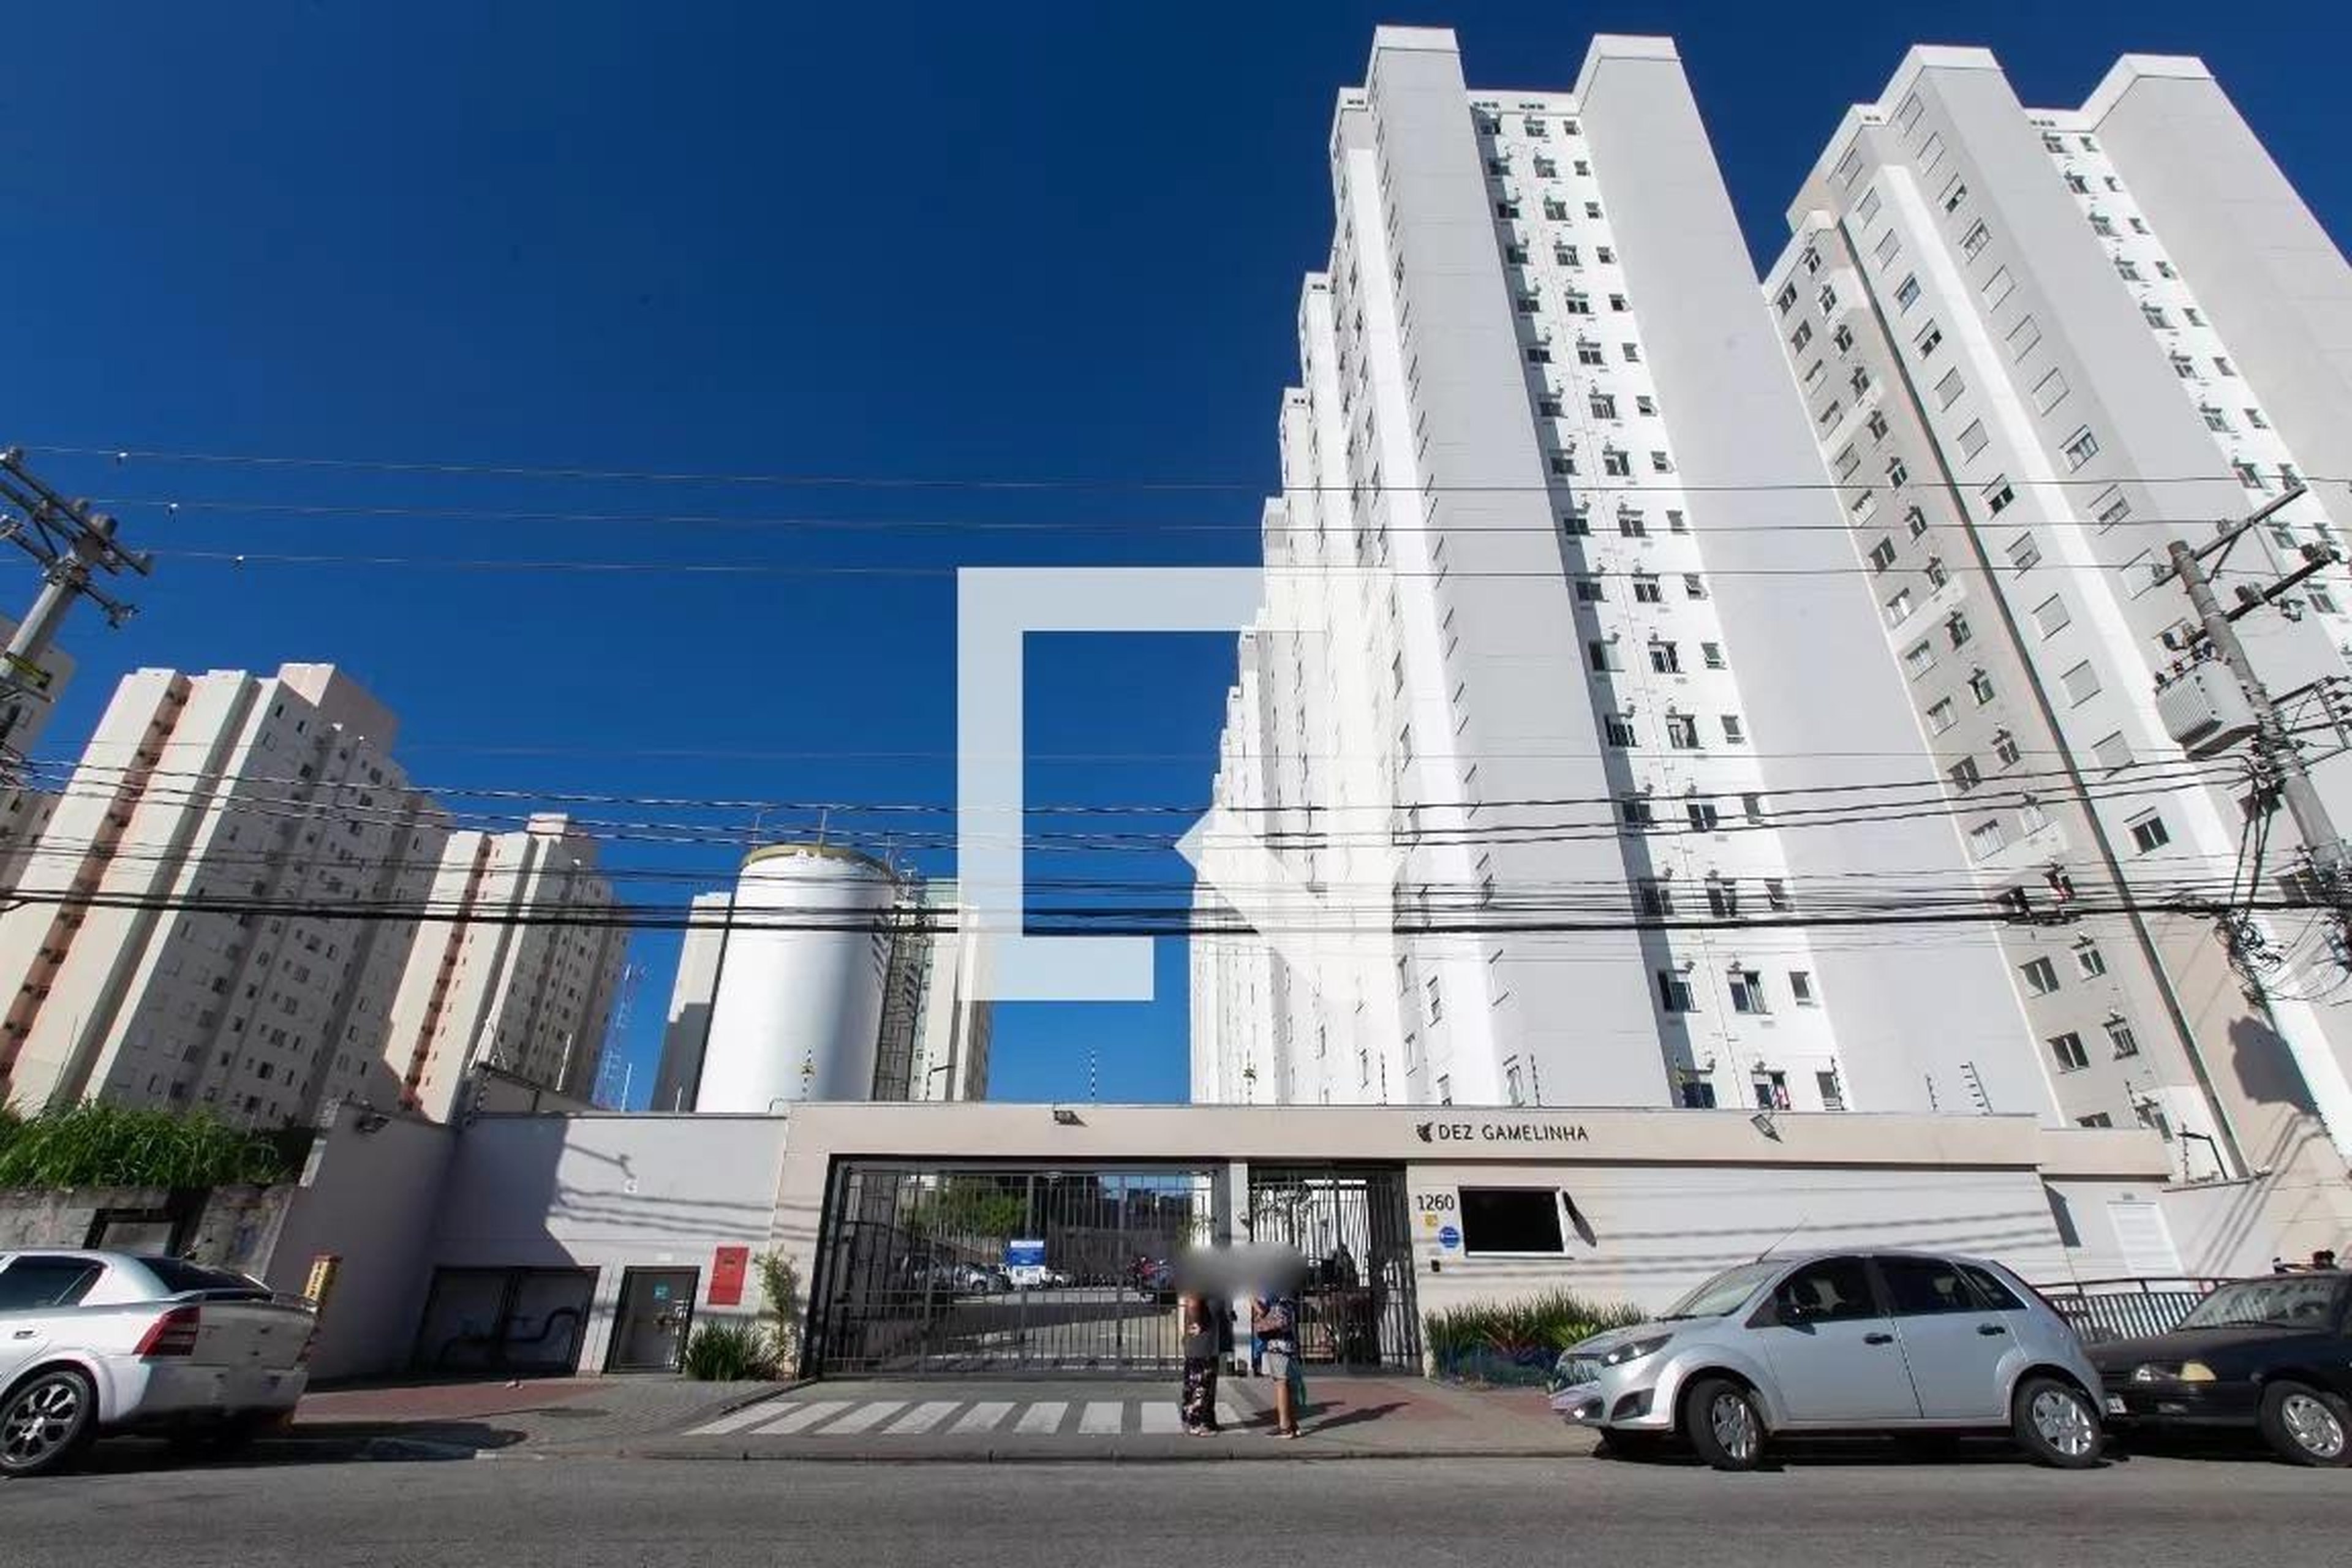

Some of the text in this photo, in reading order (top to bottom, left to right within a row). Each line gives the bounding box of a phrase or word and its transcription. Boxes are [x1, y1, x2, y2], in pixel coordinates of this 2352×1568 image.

[1439, 1124, 1589, 1141] DEZ GAMELINHA
[1416, 1194, 1455, 1212] 1260
